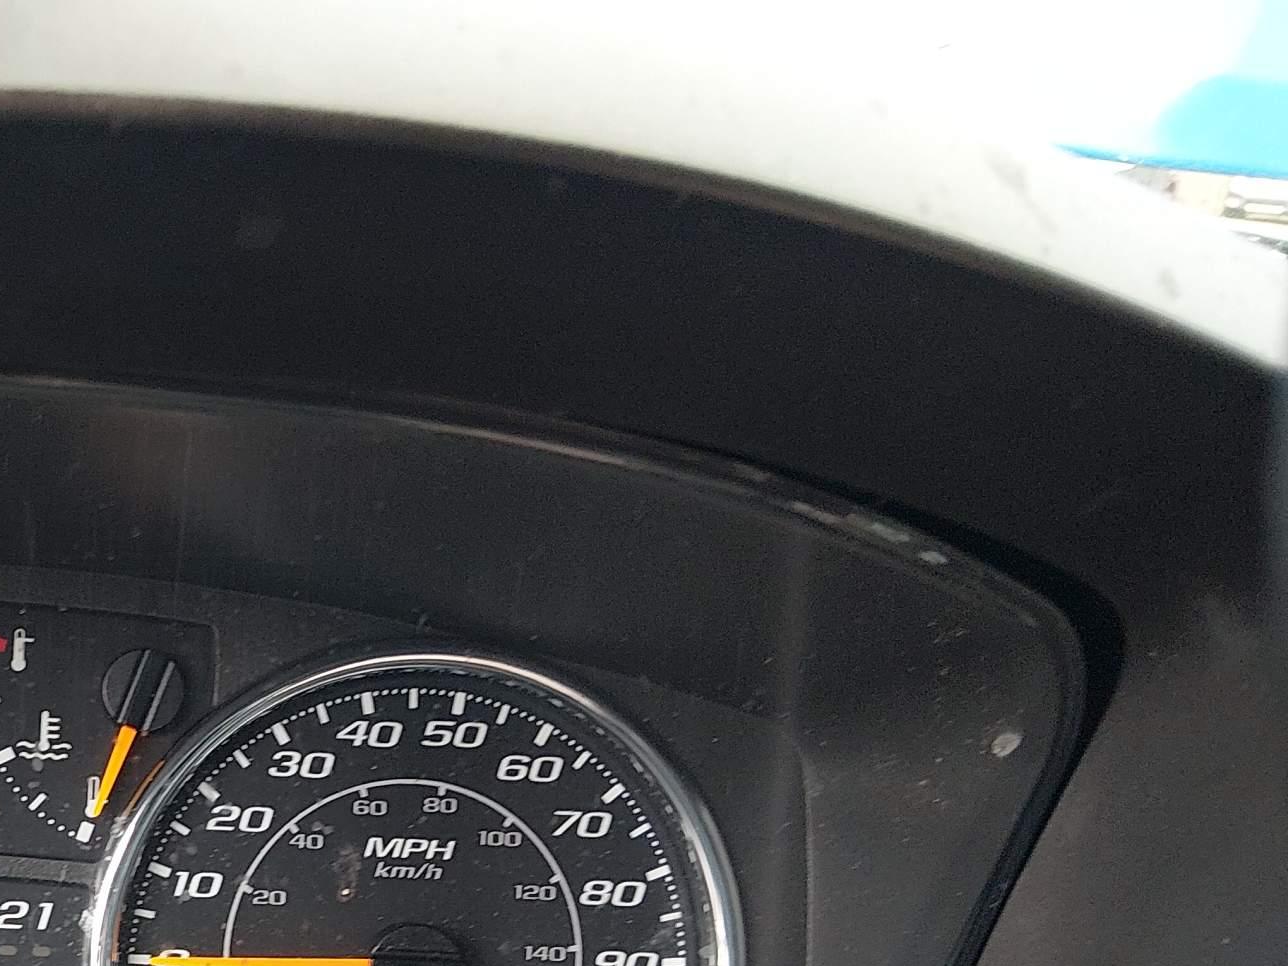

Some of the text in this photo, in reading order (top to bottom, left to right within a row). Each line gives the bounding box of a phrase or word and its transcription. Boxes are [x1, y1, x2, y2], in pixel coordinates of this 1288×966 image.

[336, 721, 404, 748] 40
[420, 721, 488, 748] 50
[267, 750, 335, 779] 30
[495, 754, 565, 783] 60
[352, 799, 389, 817] 60
[421, 796, 458, 815] 80
[205, 805, 275, 834] 20
[552, 809, 613, 838] 70
[288, 833, 325, 851] 40
[363, 836, 456, 861] MPH
[478, 830, 523, 848] 100
[374, 861, 444, 881] km/h
[173, 870, 223, 898] 10
[513, 883, 557, 901] 120
[579, 880, 647, 907] 80
[251, 888, 288, 907] 20
[524, 945, 568, 962] 140
